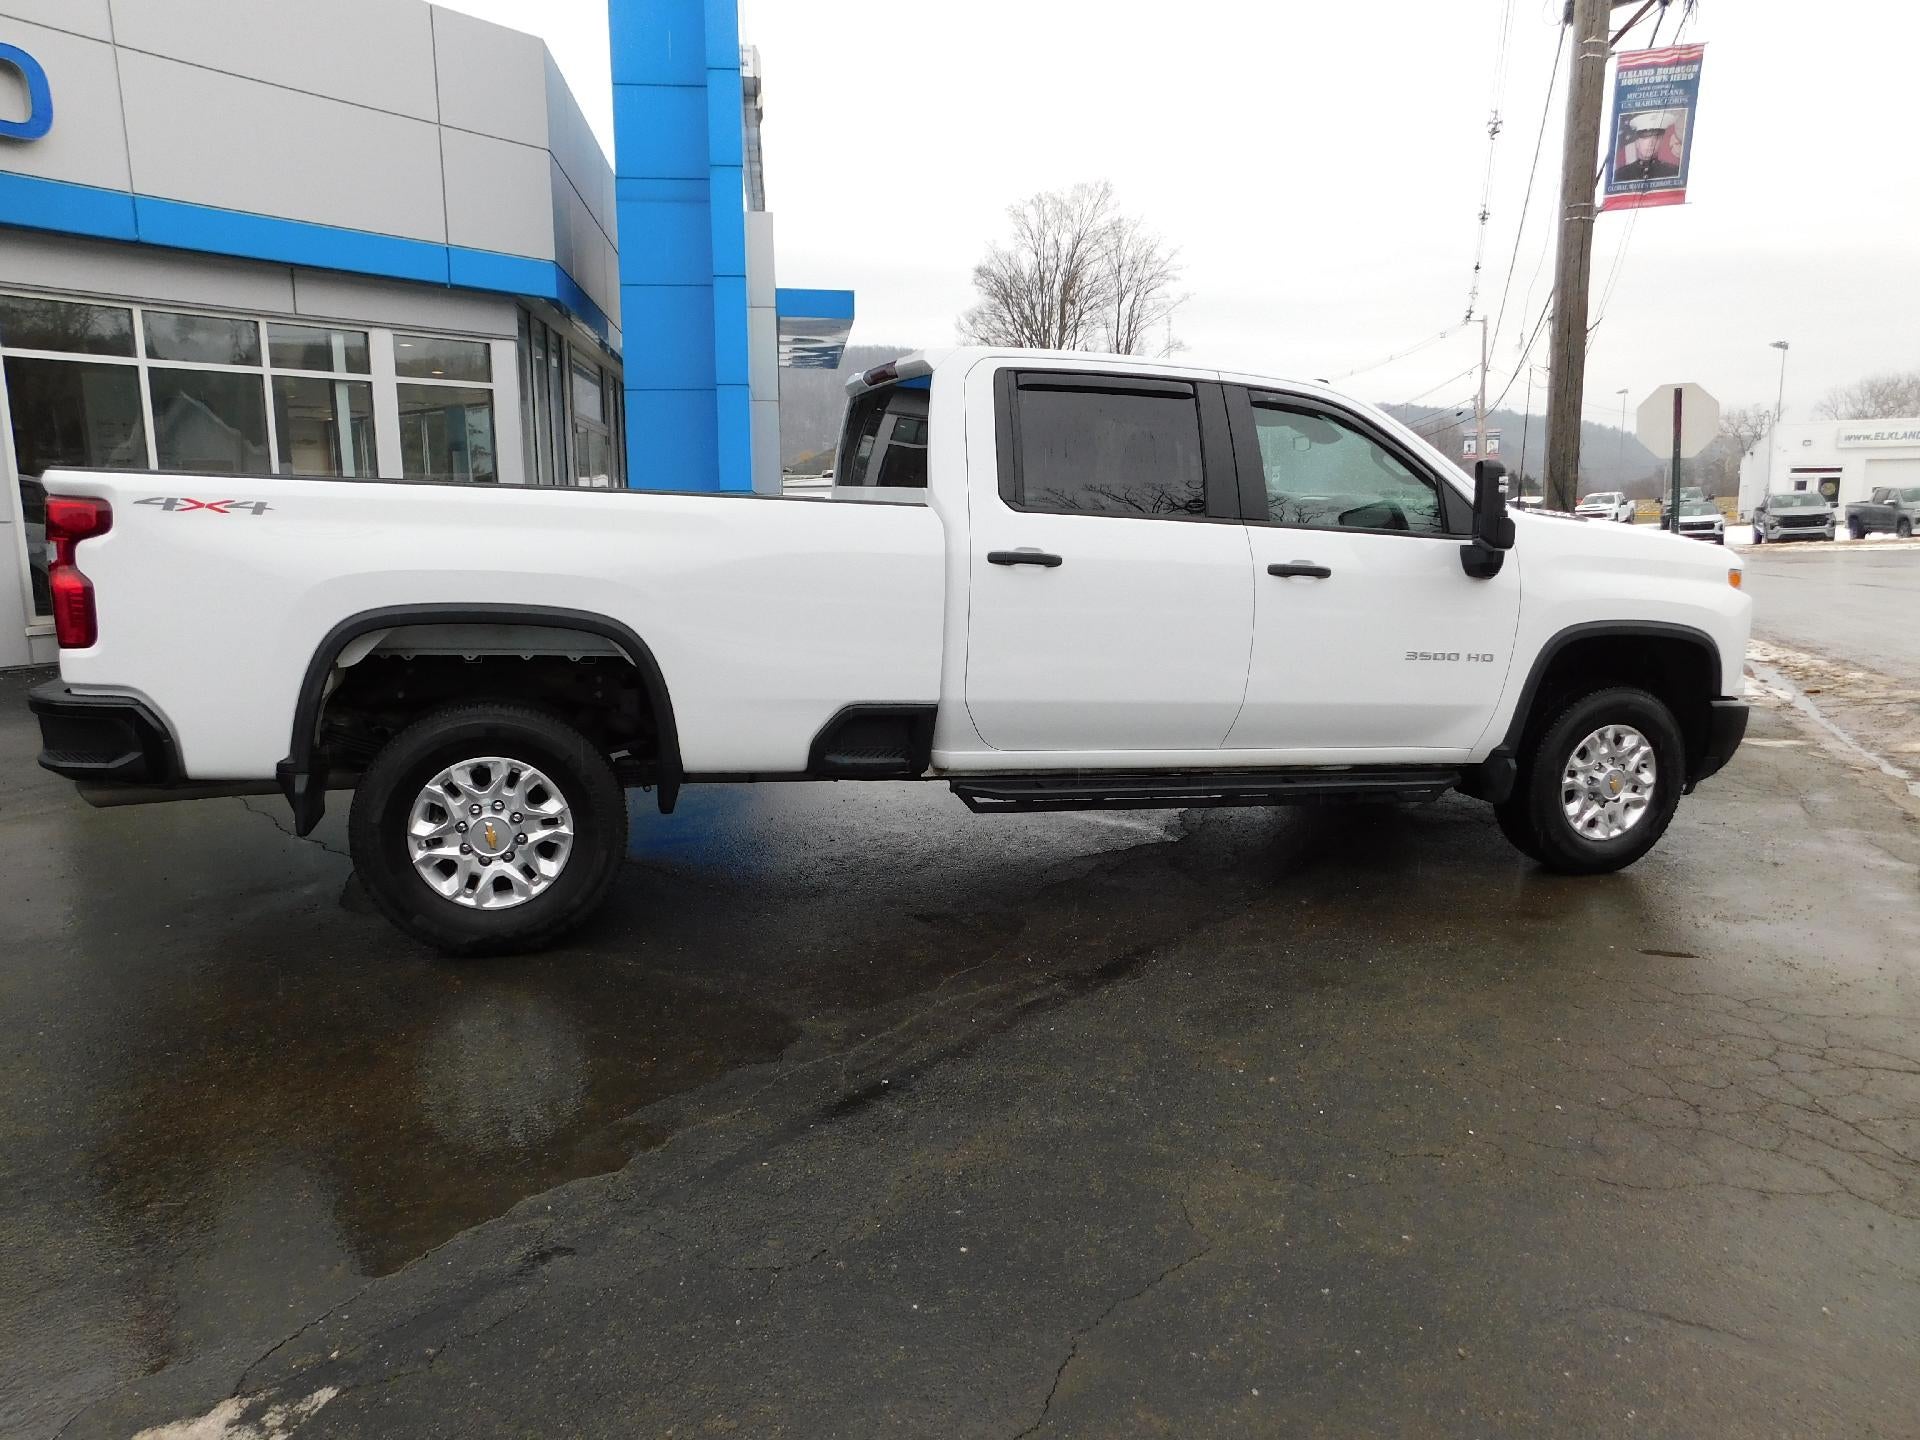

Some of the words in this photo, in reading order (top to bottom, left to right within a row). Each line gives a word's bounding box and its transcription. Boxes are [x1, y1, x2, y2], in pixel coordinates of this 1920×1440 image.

[1618, 69, 1655, 80] ELKLAND
[1621, 75, 1669, 87] HOMETOWN
[1669, 73, 1694, 82] HERO
[1626, 91, 1659, 100] MICHAEL
[1635, 100, 1662, 108] MARINE
[1405, 651, 1460, 661] 3500
[1467, 653, 1494, 663] HD
